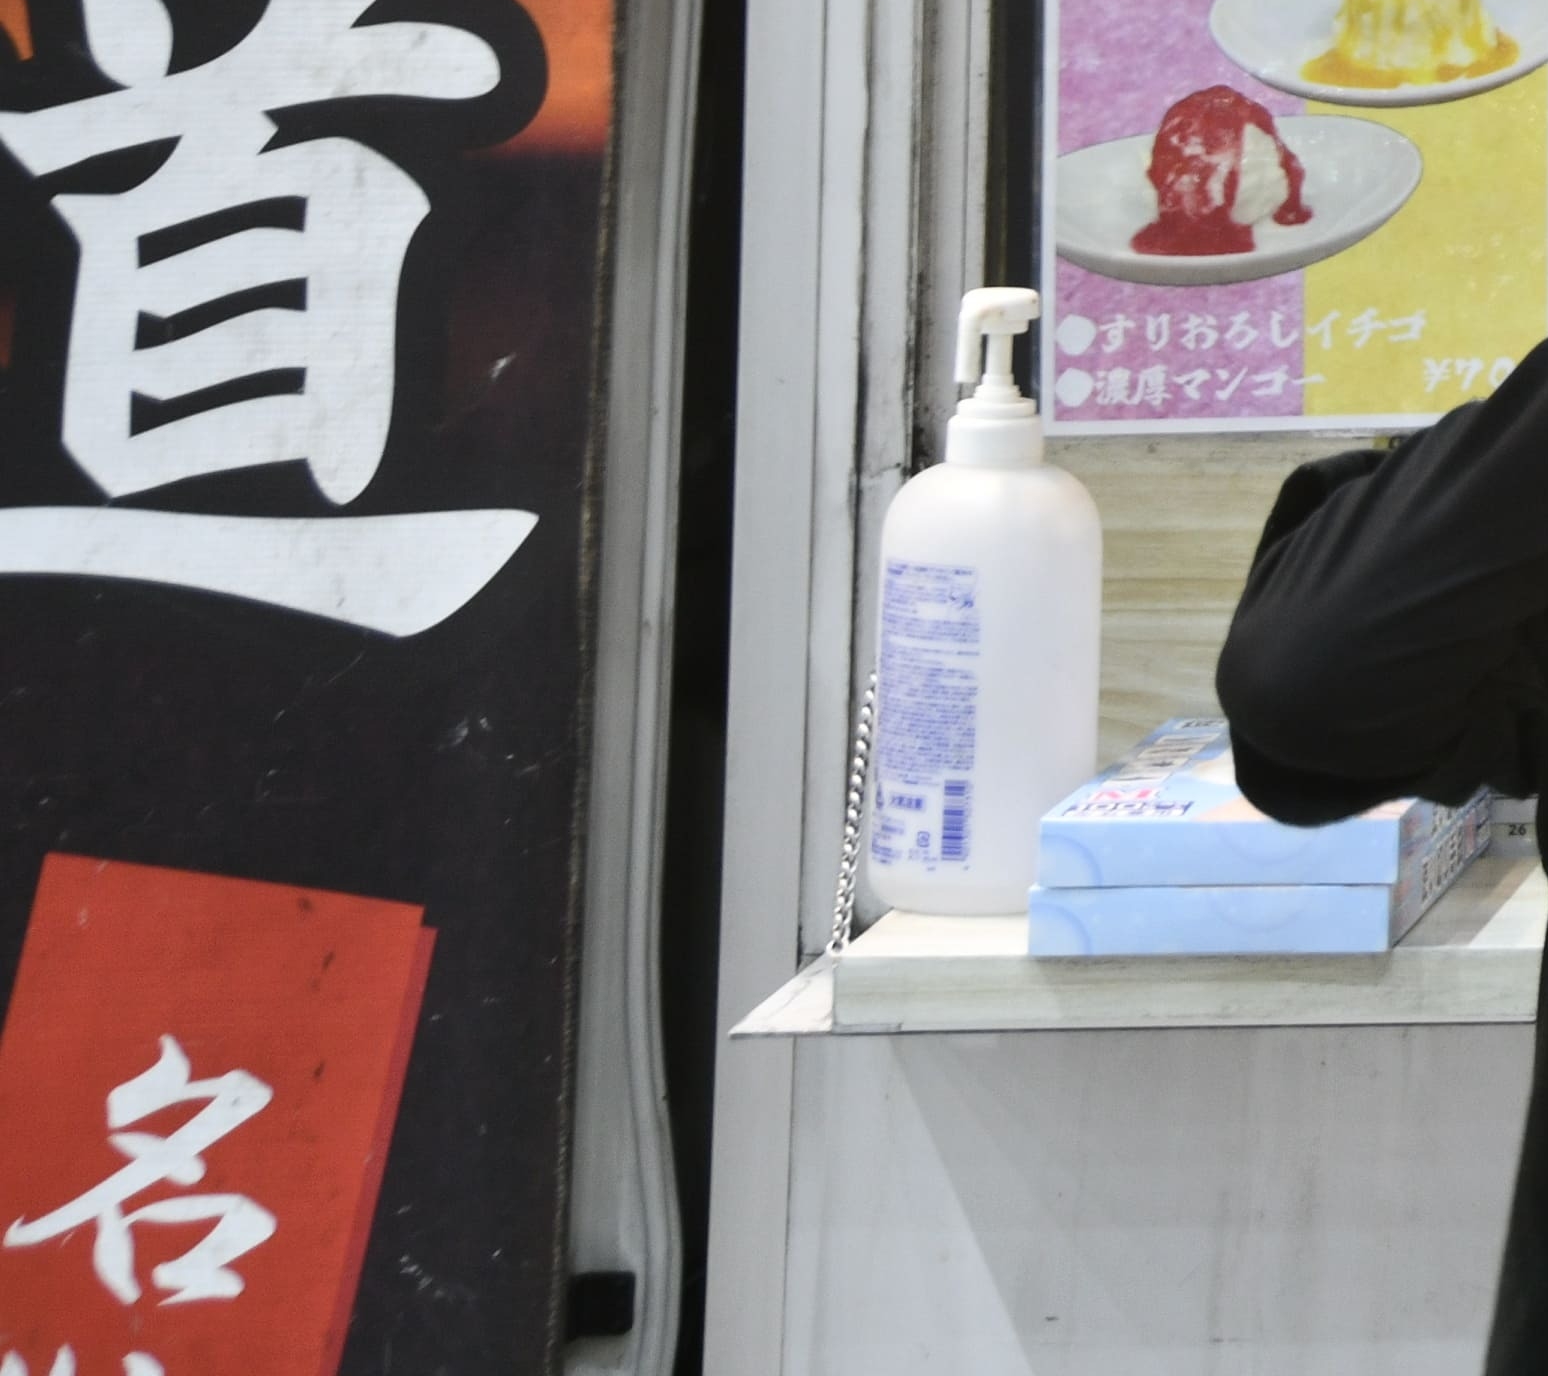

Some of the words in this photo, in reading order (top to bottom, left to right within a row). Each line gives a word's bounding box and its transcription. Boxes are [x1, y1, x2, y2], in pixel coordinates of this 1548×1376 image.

[1101, 308, 1428, 354] すりおろしイチゴ
[1095, 363, 1328, 408] 濃厚マンゴー
